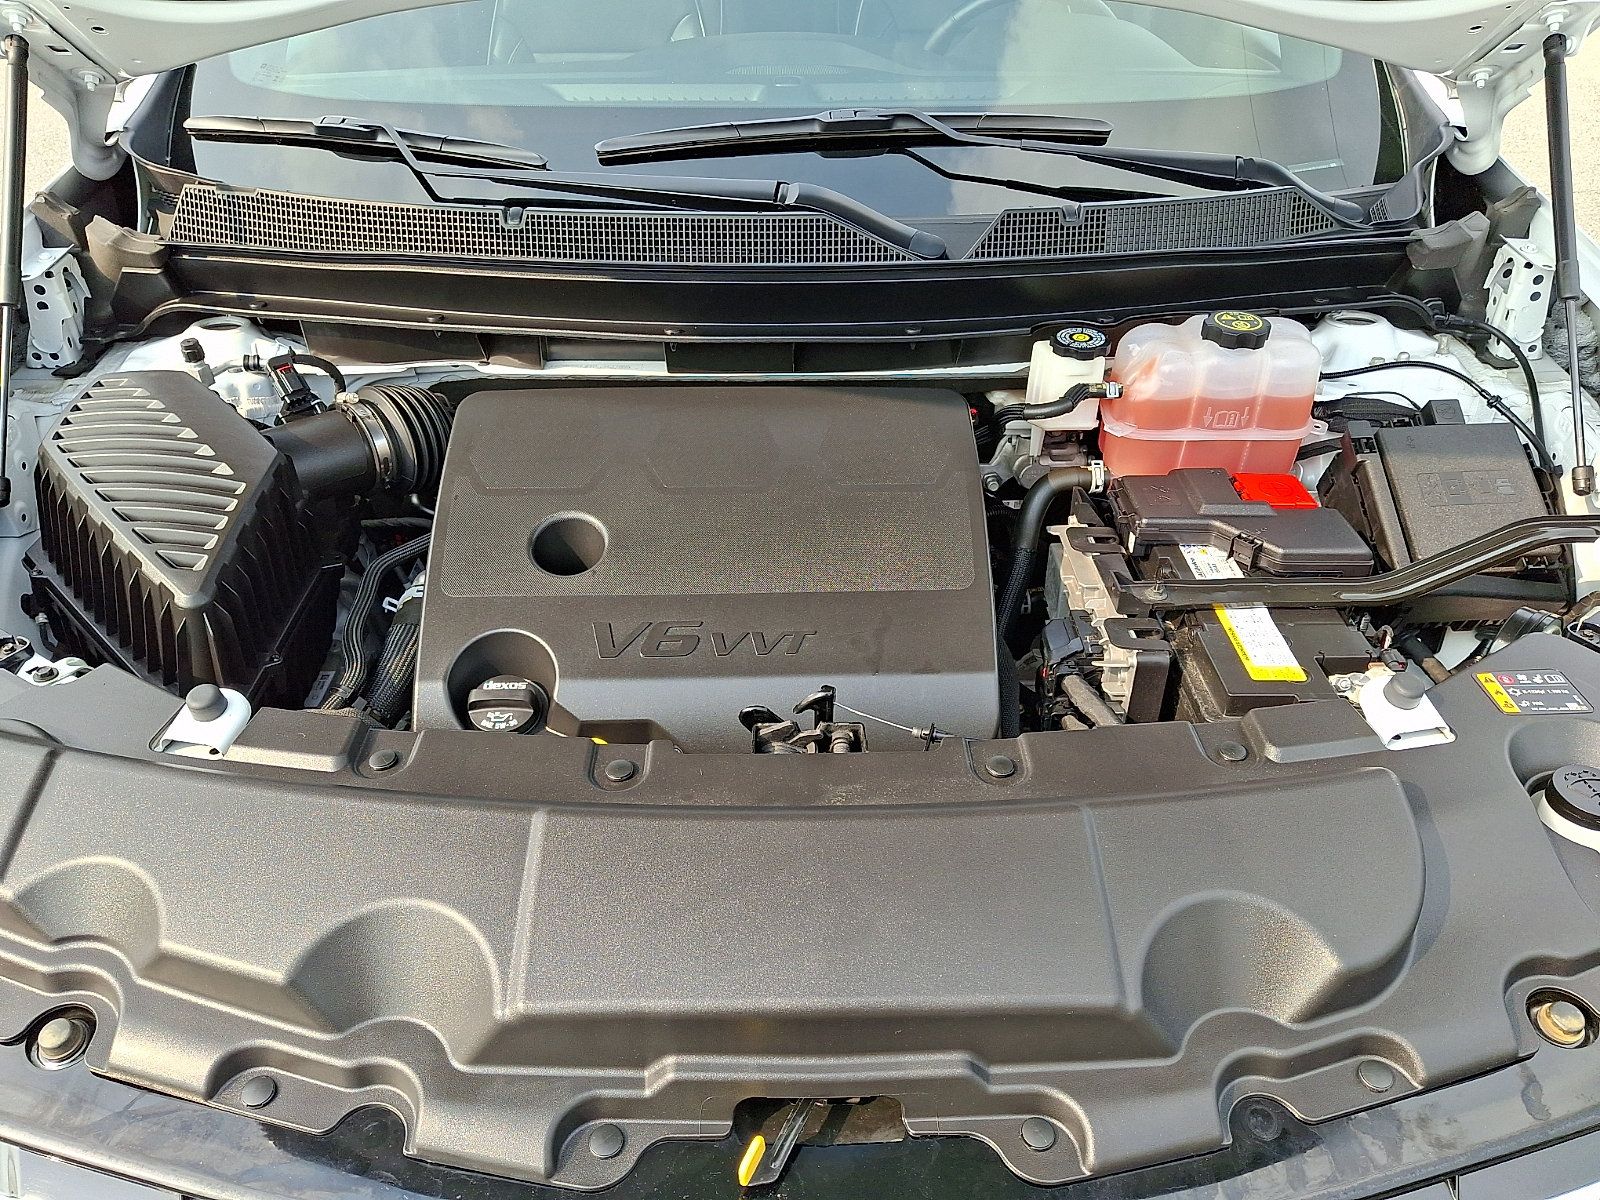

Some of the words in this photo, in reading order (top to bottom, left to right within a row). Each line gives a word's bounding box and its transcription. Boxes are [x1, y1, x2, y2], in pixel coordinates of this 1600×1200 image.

[592, 621, 704, 659] V6
[711, 630, 818, 657] VVT
[483, 680, 529, 690] dexos
